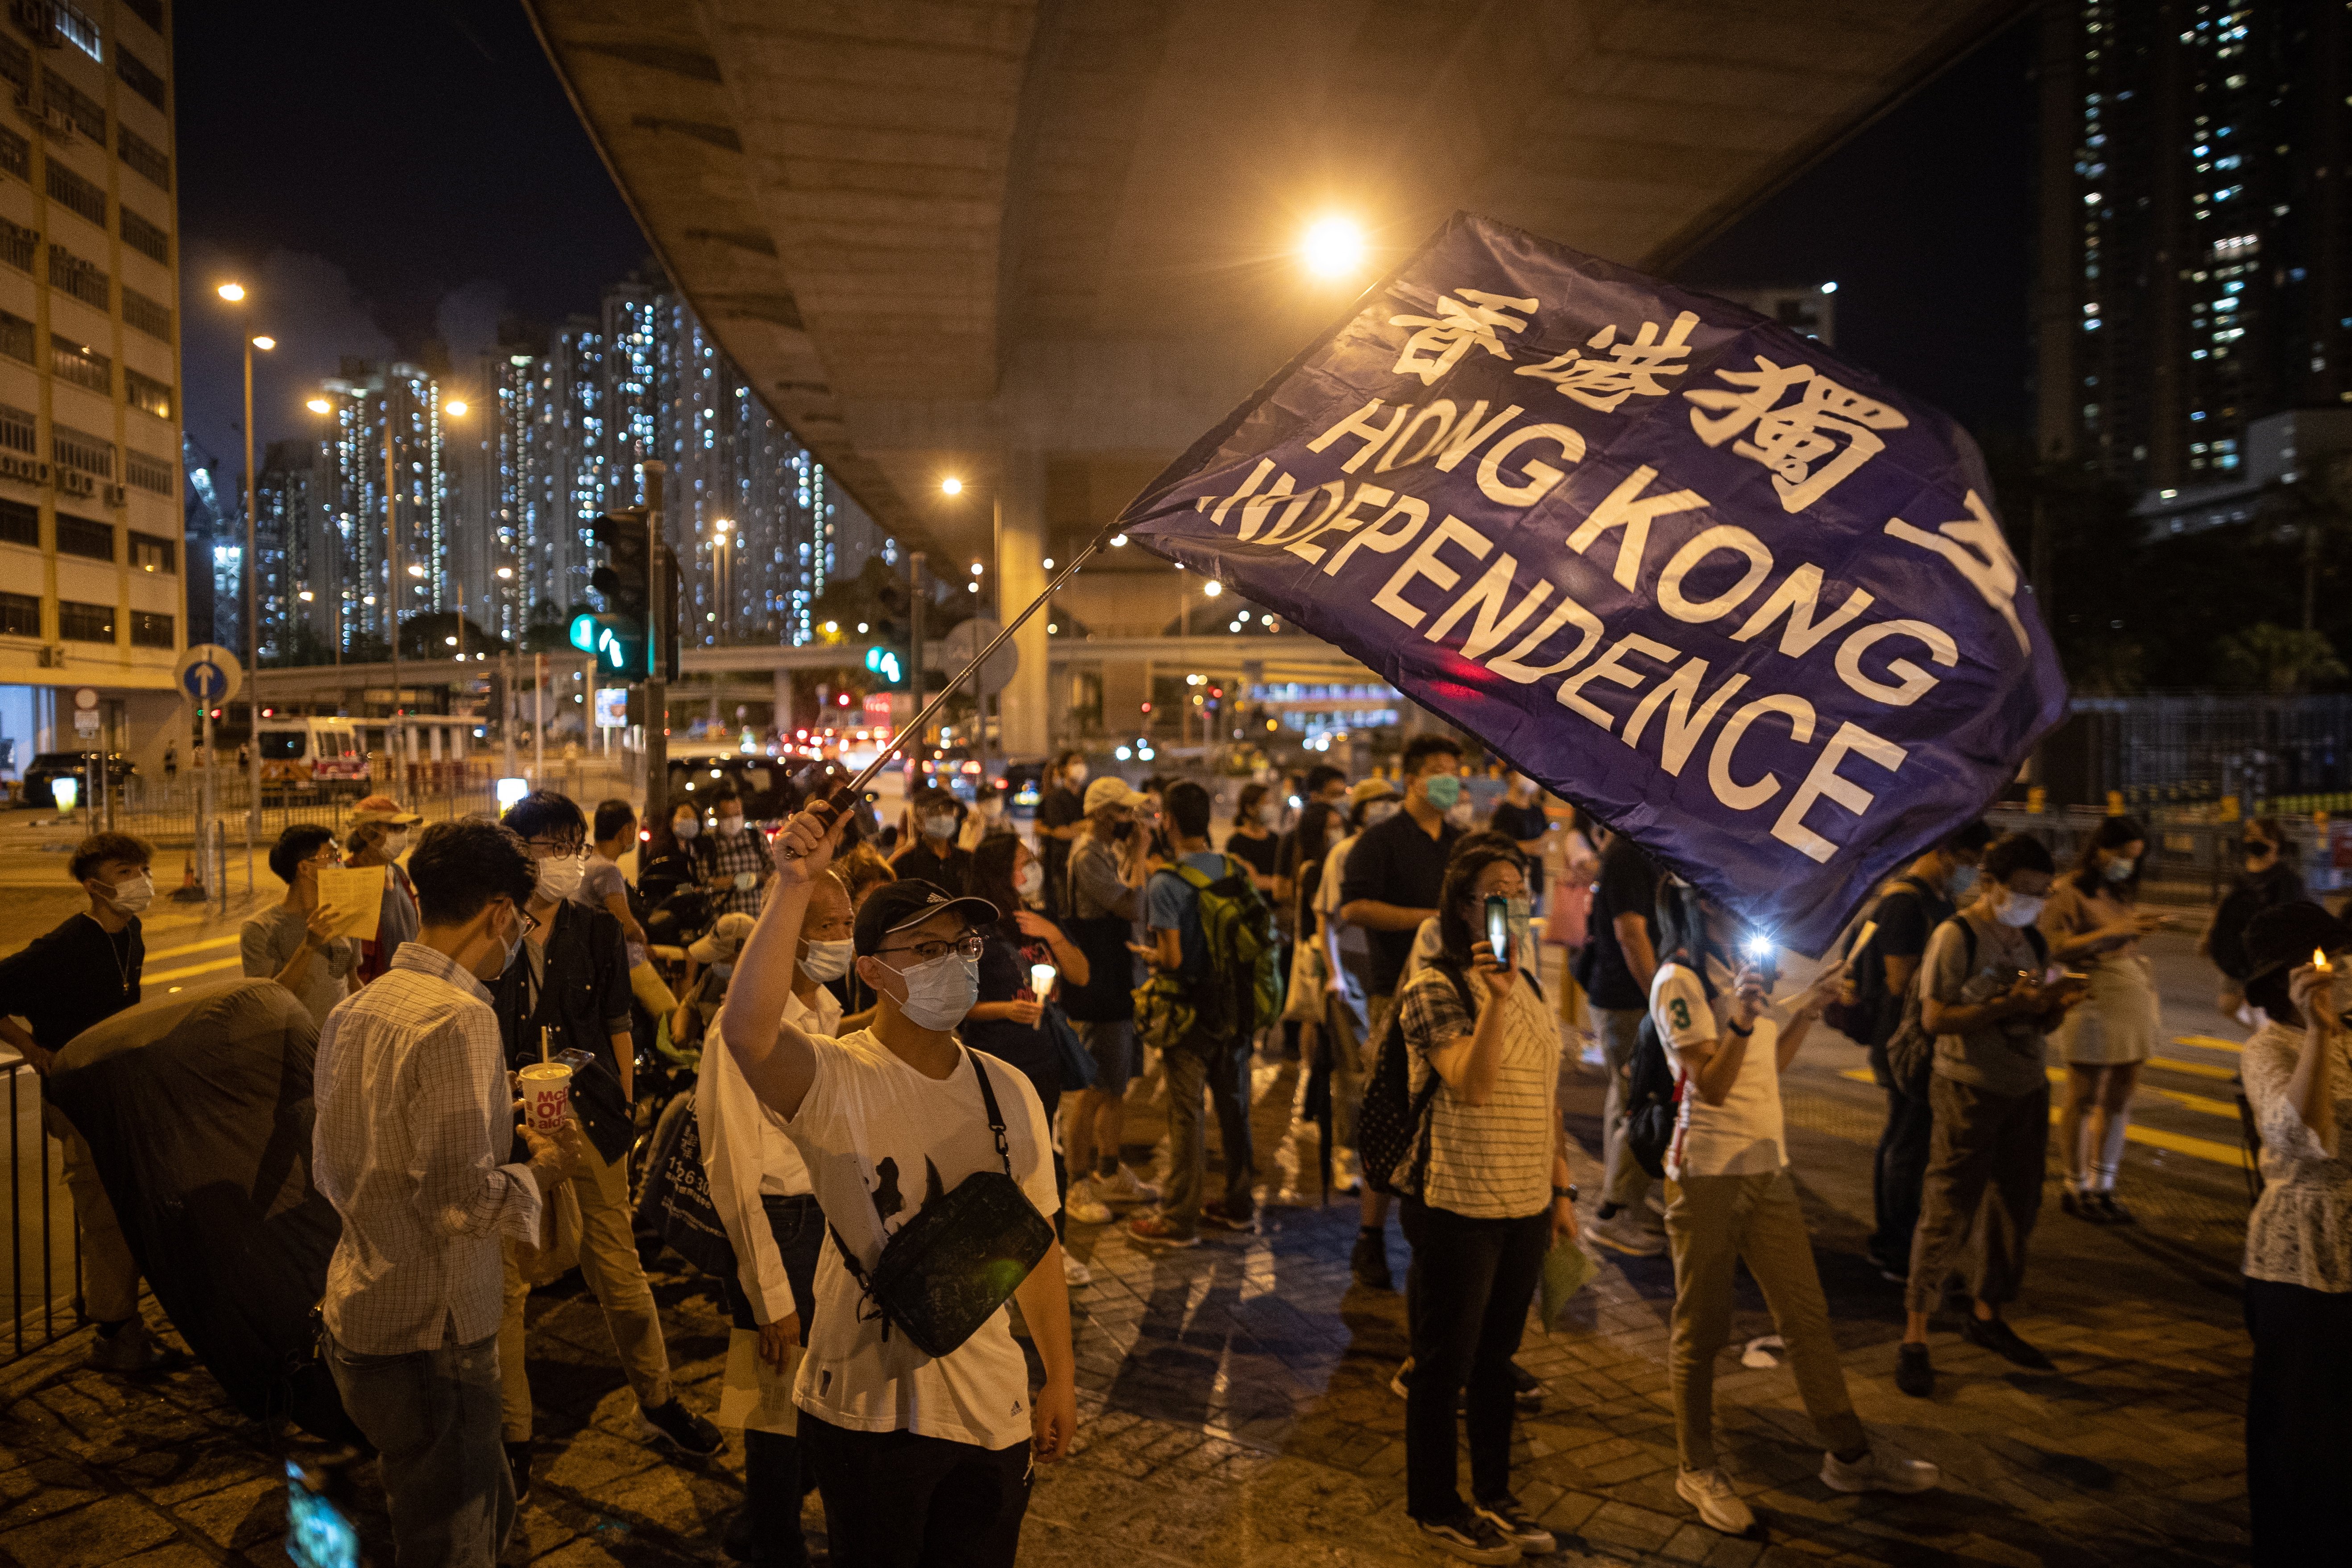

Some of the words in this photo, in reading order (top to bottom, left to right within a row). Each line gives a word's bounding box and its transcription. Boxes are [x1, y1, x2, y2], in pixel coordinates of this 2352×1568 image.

[1197, 458, 1908, 863] INDEPENDENCE
[1307, 398, 1586, 507] HONG
[1565, 465, 1958, 706] KONG
[1669, 997, 1691, 1029] 3
